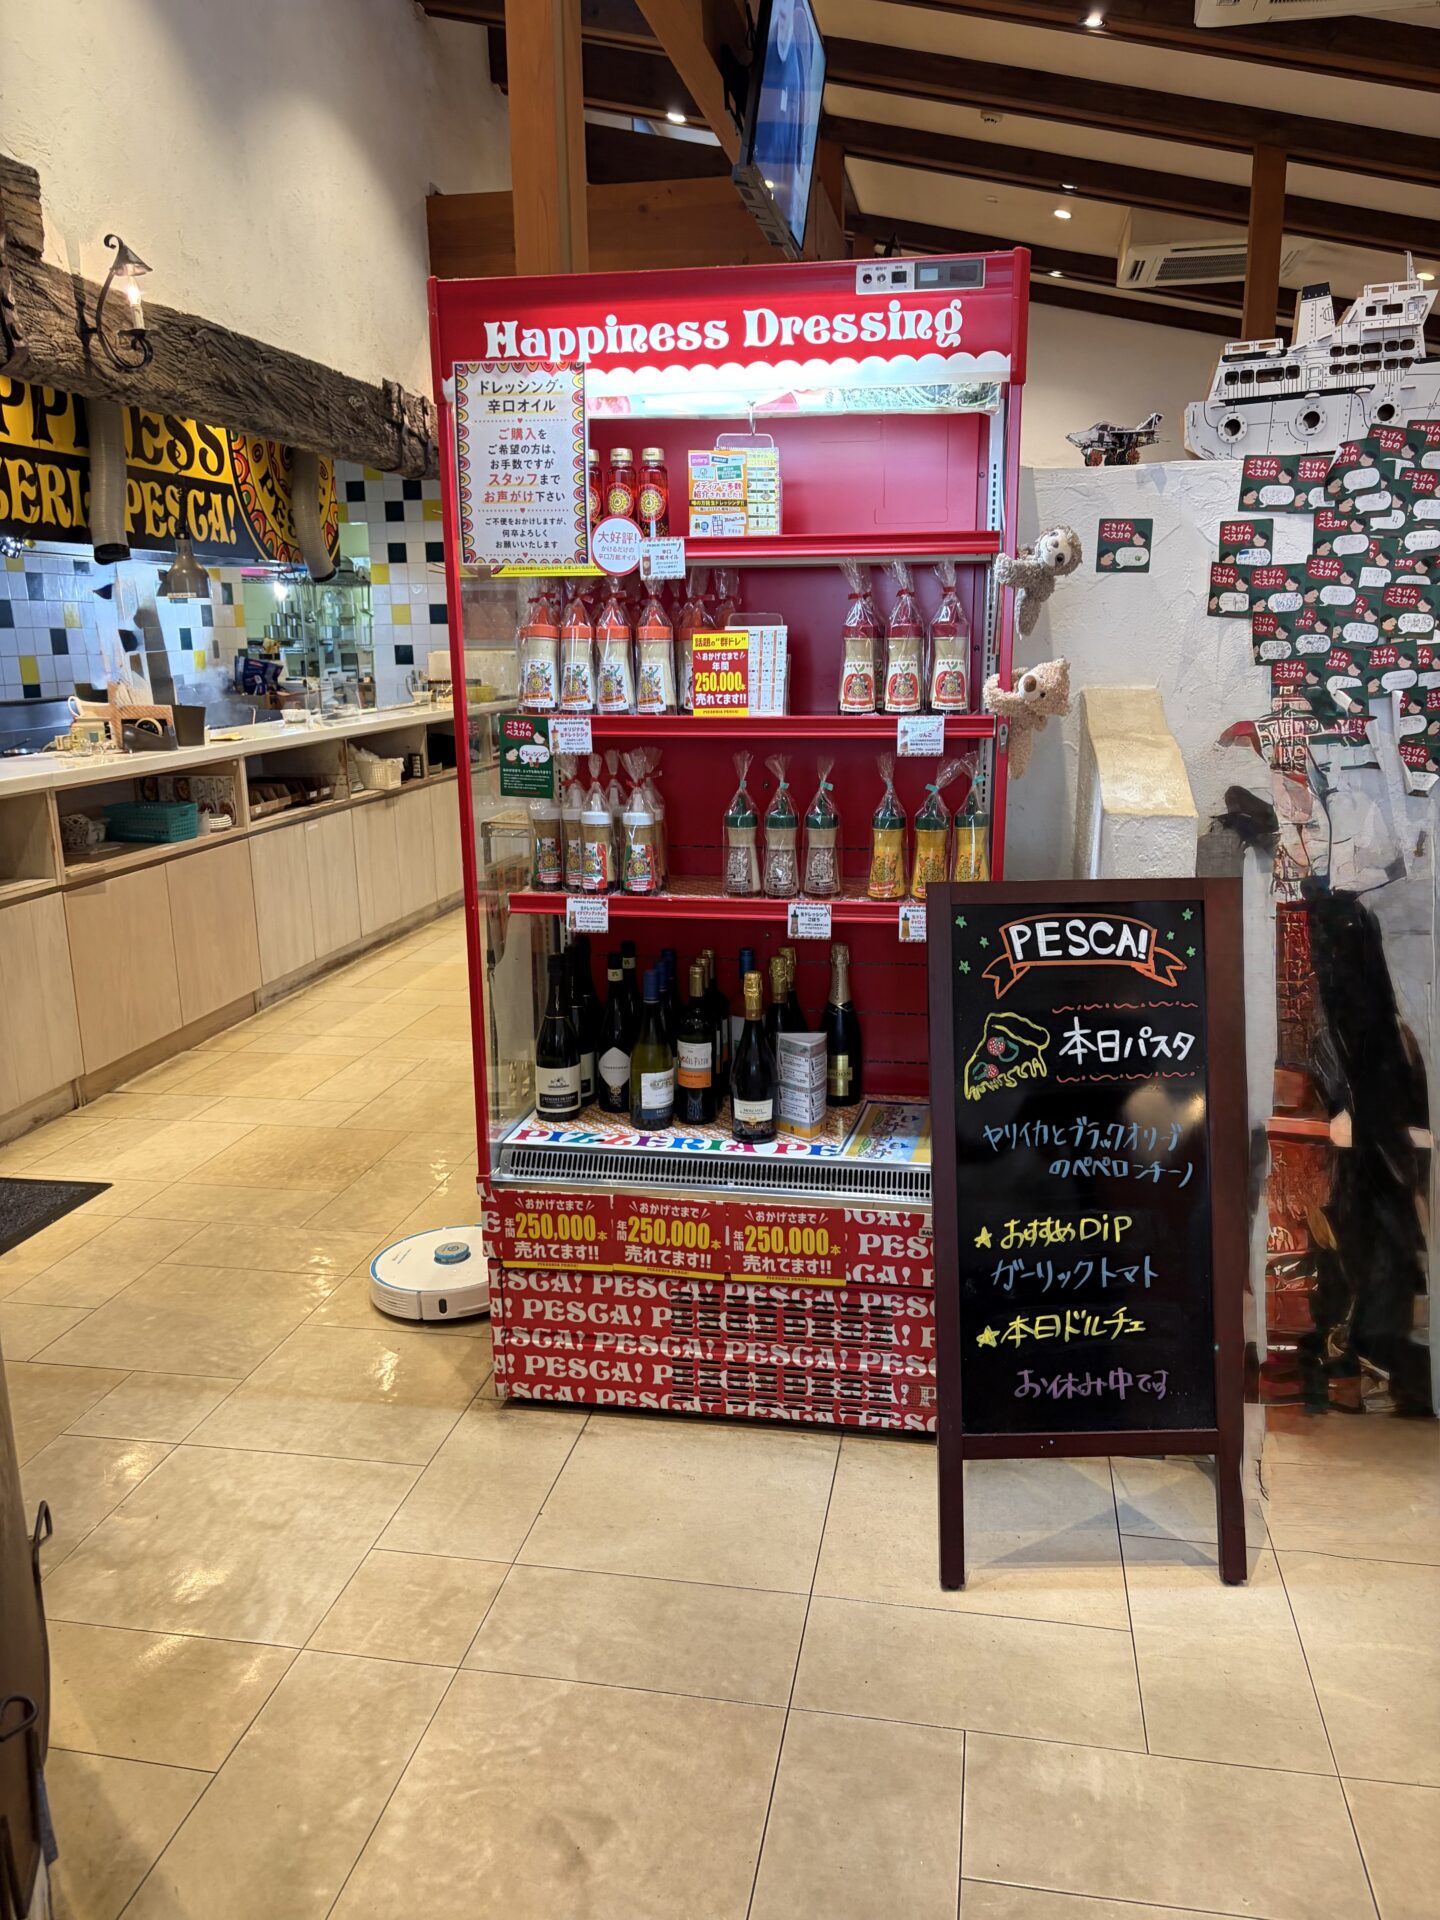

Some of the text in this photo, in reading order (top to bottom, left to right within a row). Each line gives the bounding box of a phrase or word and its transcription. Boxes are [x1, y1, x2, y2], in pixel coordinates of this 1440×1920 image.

[484, 299, 963, 361] Happiness Dressing
[488, 399, 556, 414] 辛口オイル
[498, 427, 548, 441] ご購入を
[488, 444, 557, 455] ご希望の方は、
[490, 459, 555, 470] お手数ですが
[1248, 460, 1278, 469] ごきげん
[1247, 469, 1277, 478] ペスカの
[1404, 471, 1435, 482] ごきげん
[488, 473, 561, 486] スタッフまで
[694, 482, 742, 491] メディアで多数
[484, 491, 566, 503] お声がけ下さい
[124, 479, 237, 544] PESCA!
[485, 517, 568, 527] ご不便をおかけしますが、
[1103, 522, 1132, 531] ごきげん
[1318, 519, 1348, 528] ペスカの
[502, 529, 549, 538] 何卒よろしく
[1224, 525, 1252, 533] ごきげん
[597, 531, 638, 545] 大好評!
[1102, 531, 1131, 540] ペスカの
[1223, 533, 1251, 542] ペスカの
[496, 540, 559, 549] お願いいたします
[1310, 560, 1340, 569] ごきげん
[1254, 569, 1284, 578] ごきげん
[1309, 568, 1339, 577] ペスカの
[1253, 577, 1283, 586] ペスカの
[1388, 587, 1418, 596] ごきげん
[1386, 596, 1416, 605] ペスカの
[701, 652, 739, 661] おかげさまで
[712, 661, 730, 671] 年間
[1276, 663, 1304, 671] ごきげん
[1275, 671, 1303, 679] ペスカの
[695, 693, 747, 706] 売れてます!!
[506, 721, 532, 729] ごきげん
[506, 729, 532, 737] ペスカの
[1008, 919, 1149, 961] PESCA!
[1058, 1016, 1196, 1065] 本日パスタ
[516, 1129, 757, 1154] PIZZERIA
[1048, 1156, 1194, 1189] のペペロンチーノ
[525, 1199, 584, 1212] おかげさまで
[639, 1201, 700, 1218] おかげさまで
[755, 1210, 817, 1224] おかげさまで
[514, 1241, 599, 1261] 売れてます!!
[858, 1232, 934, 1260] PES
[624, 1245, 712, 1269] 売れてます!!
[742, 1254, 832, 1275] 売れてます!!
[990, 1255, 1159, 1293] ガーリックトマト
[724, 1282, 849, 1312] PESCA!
[858, 1291, 935, 1318] PES
[522, 1298, 643, 1327] PESCA!
[1000, 1306, 1147, 1348] 本日ドルチェ
[593, 1331, 715, 1360] PESCA!
[724, 1340, 849, 1370] PESCA!
[858, 1350, 936, 1378] PES
[524, 1354, 643, 1384] PESCA!
